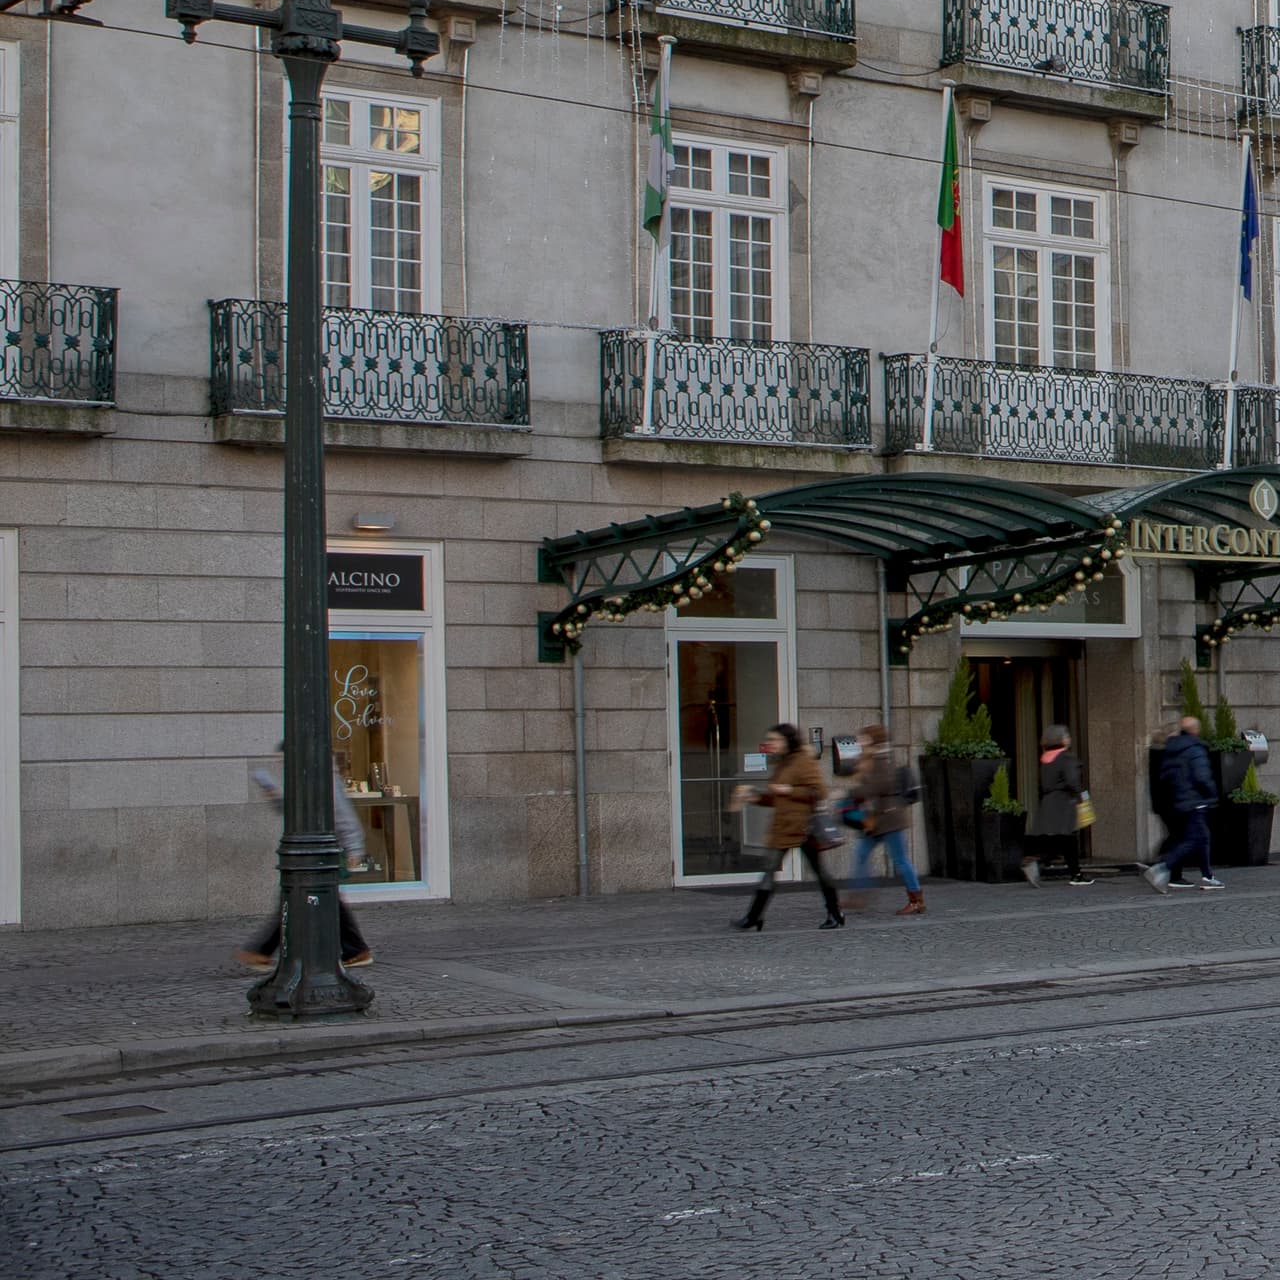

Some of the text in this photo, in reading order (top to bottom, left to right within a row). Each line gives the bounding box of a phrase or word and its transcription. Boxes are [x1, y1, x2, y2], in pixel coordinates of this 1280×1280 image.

[328, 571, 400, 587] ALCINO
[334, 664, 377, 700] Love
[334, 697, 394, 740] Silver
